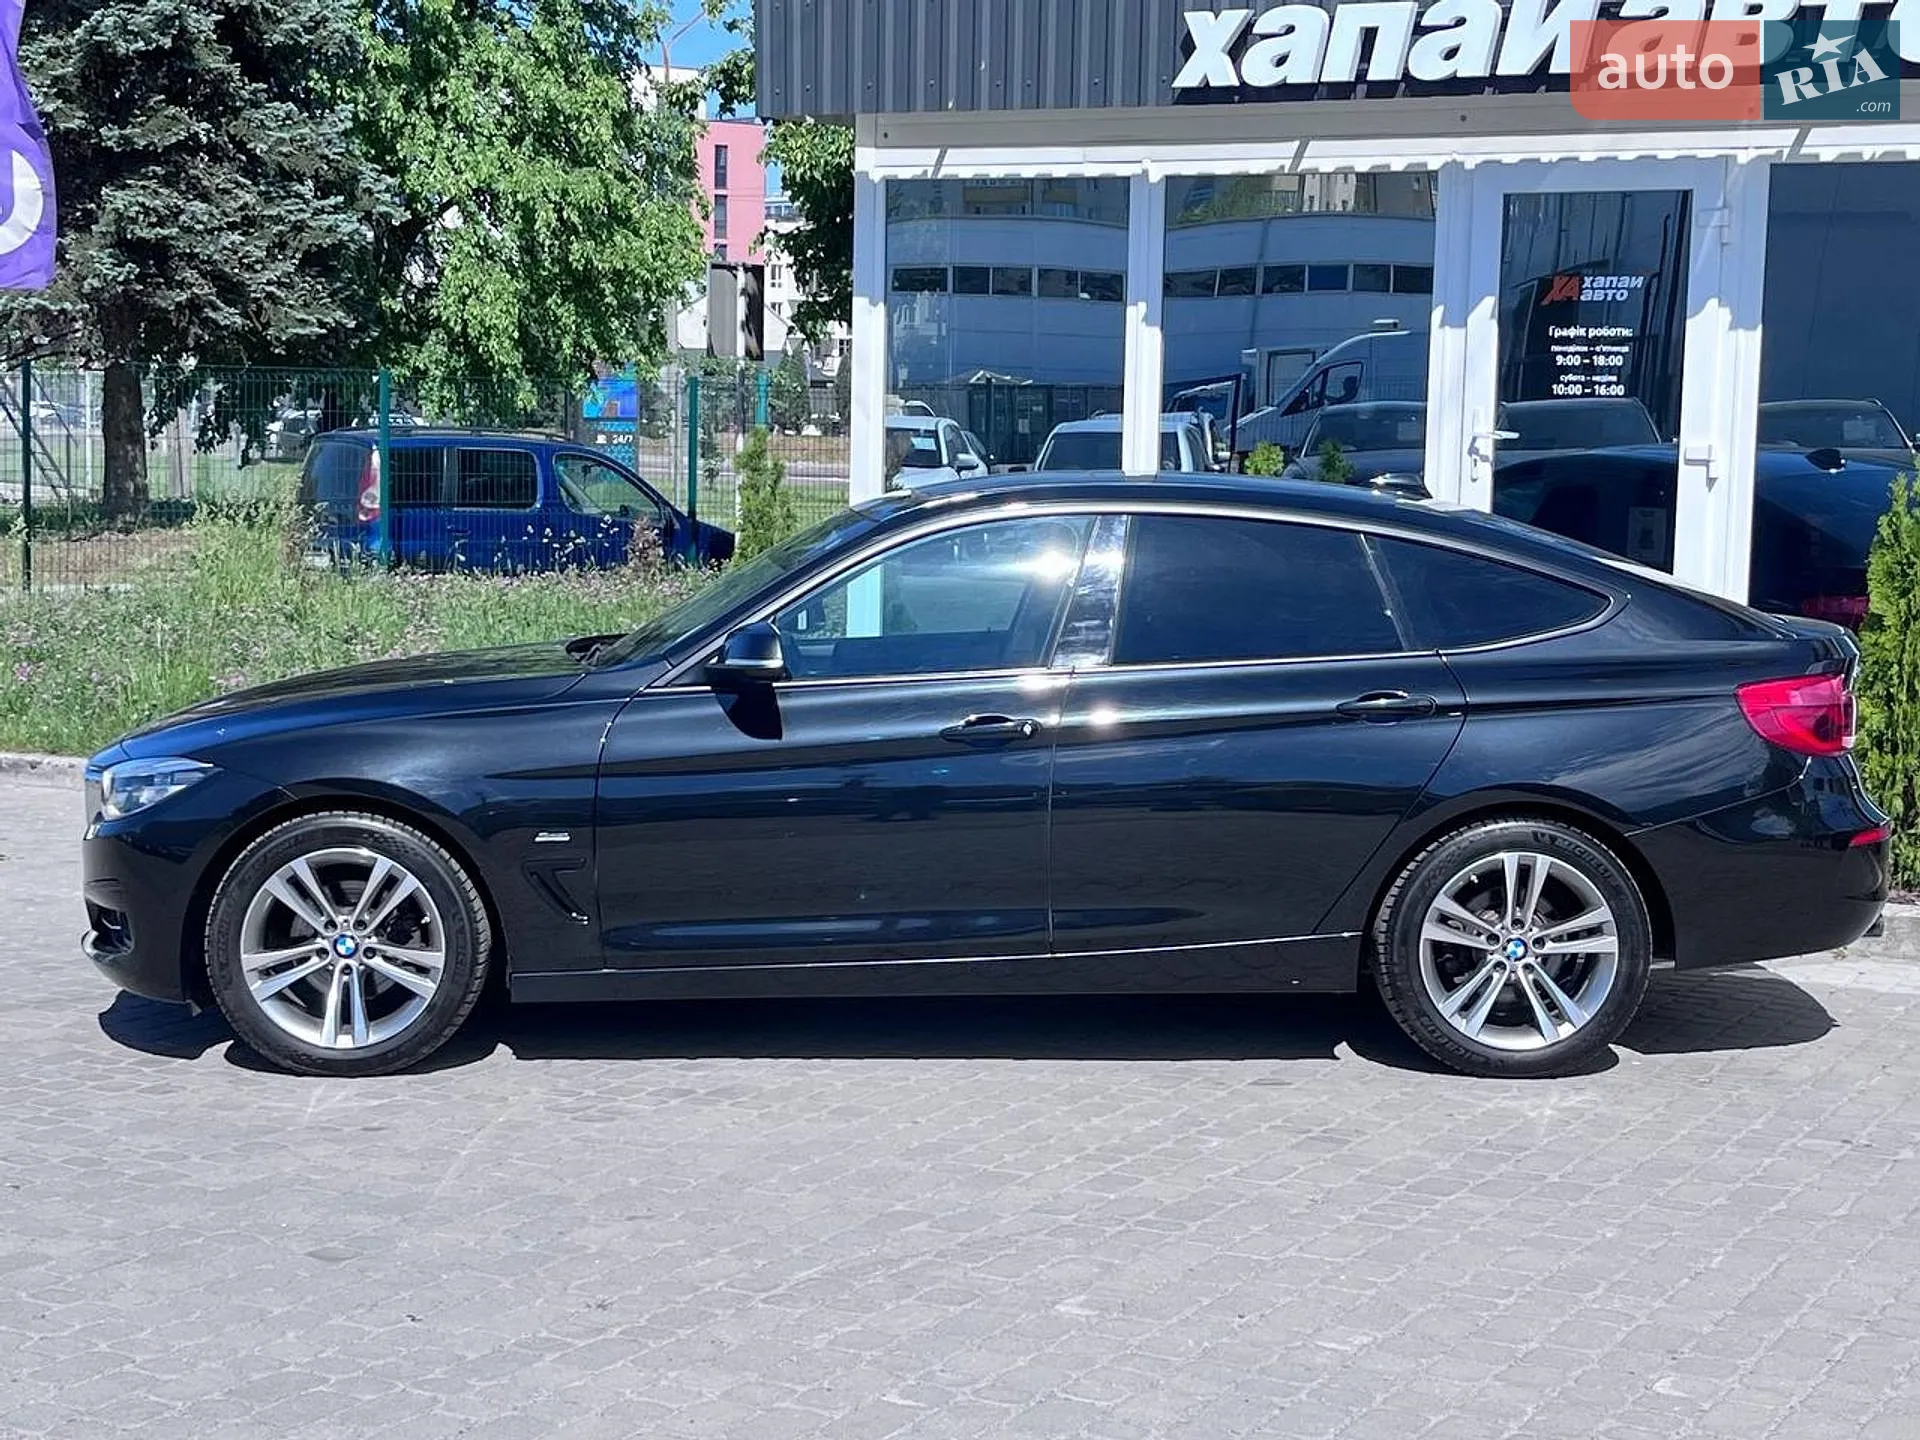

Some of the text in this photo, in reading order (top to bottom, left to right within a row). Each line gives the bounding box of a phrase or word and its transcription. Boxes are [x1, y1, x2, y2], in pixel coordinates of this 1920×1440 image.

[1580, 289, 1629, 301] авто
[1549, 325, 1634, 339] Графік роботи:
[1556, 355, 1581, 366] 9:00
[1592, 355, 1623, 366] 18:00
[1551, 384, 1583, 396] 10:00
[1593, 384, 1625, 396] 16:00
